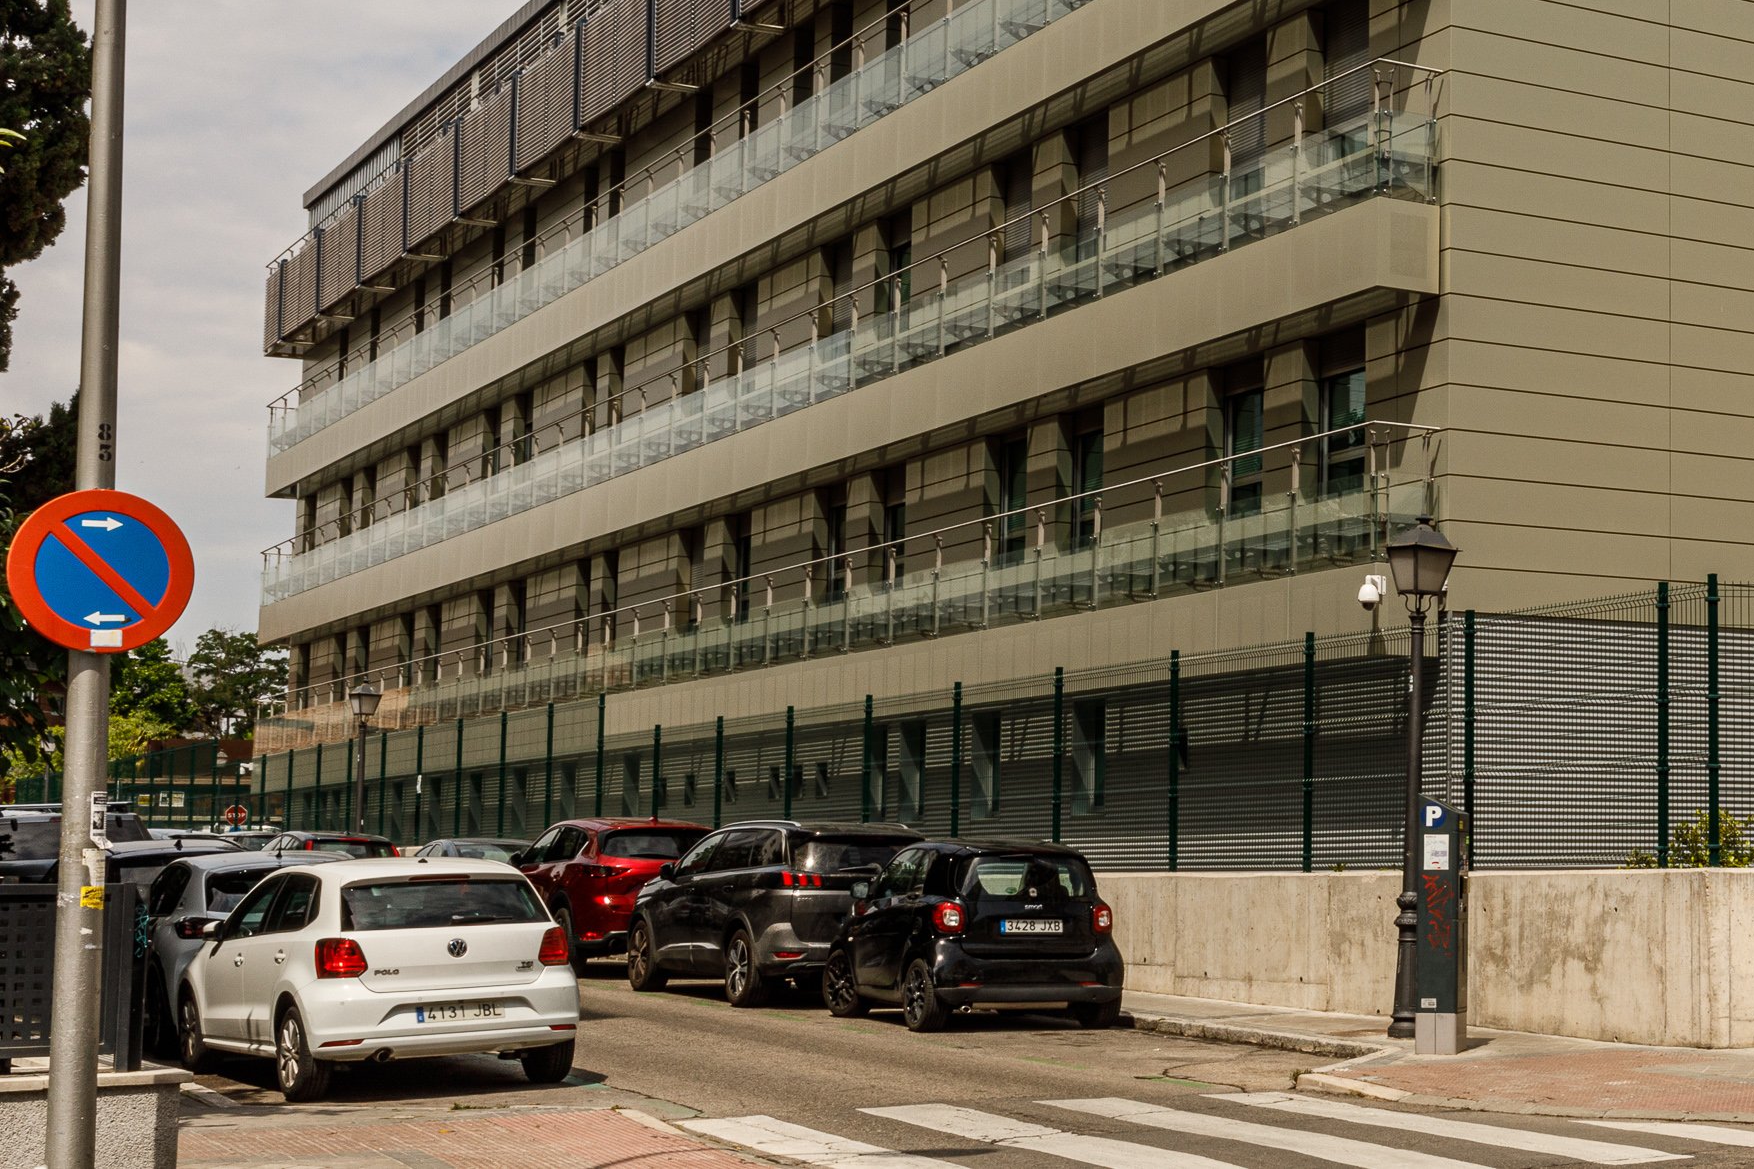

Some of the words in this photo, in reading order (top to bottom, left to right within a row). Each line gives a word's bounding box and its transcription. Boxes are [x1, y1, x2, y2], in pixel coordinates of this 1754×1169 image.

[1425, 805, 1442, 827] P
[1007, 920, 1036, 931] 3428
[1040, 920, 1061, 931] JXB
[374, 968, 399, 977] POLO
[427, 1005, 466, 1021] 4131
[473, 1003, 502, 1017] JBL
